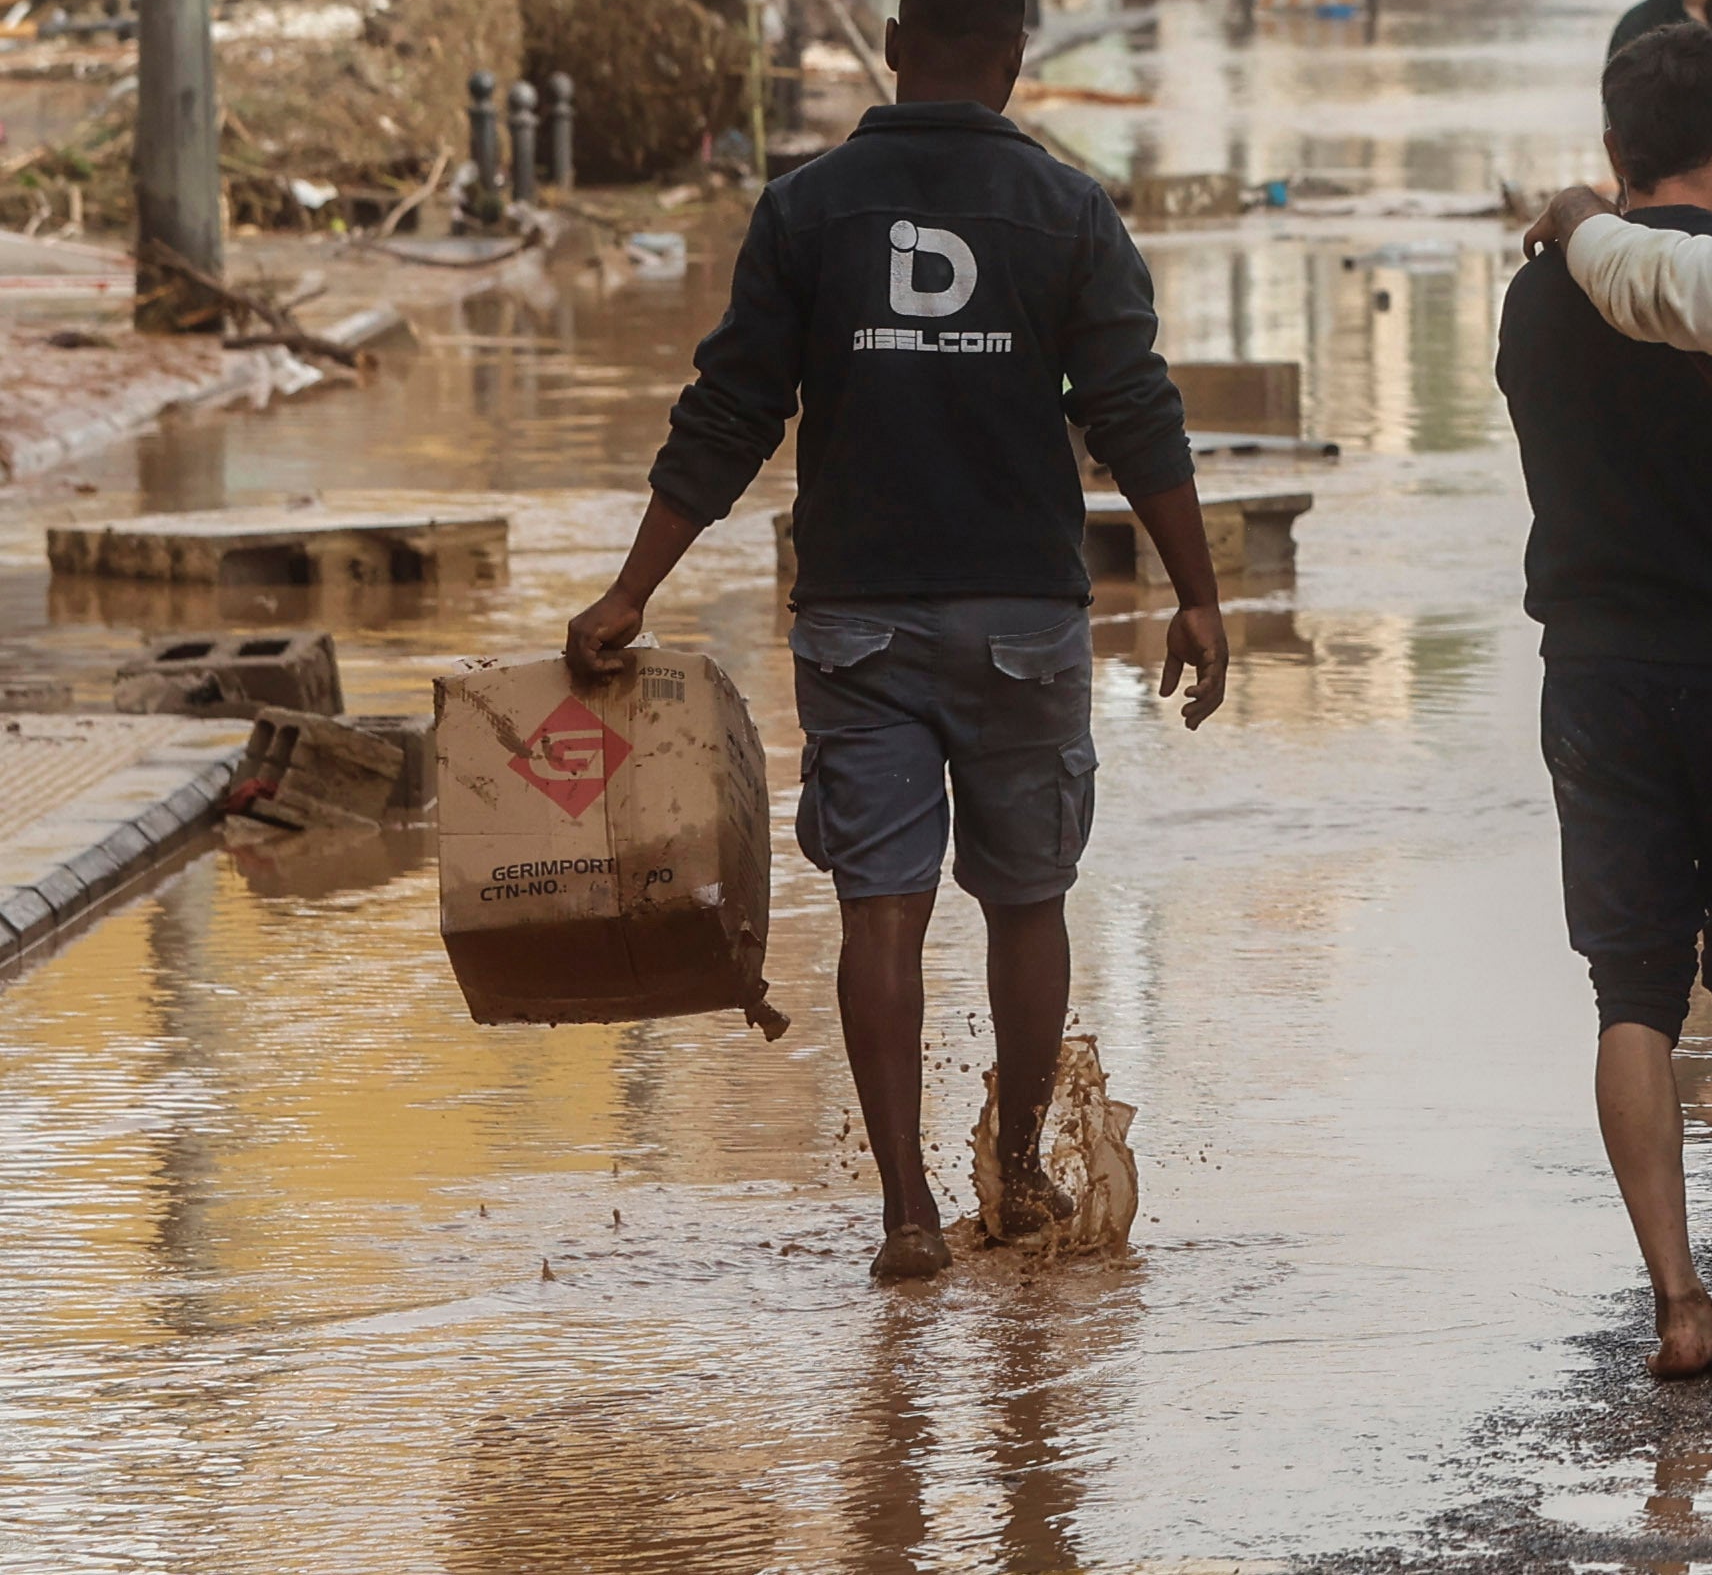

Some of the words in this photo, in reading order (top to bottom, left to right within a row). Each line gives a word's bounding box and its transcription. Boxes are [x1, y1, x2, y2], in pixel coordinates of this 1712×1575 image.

[639, 666, 685, 680] 499729
[491, 857, 614, 881] GERIMPORT
[480, 879, 567, 902] CTN-NO.:
